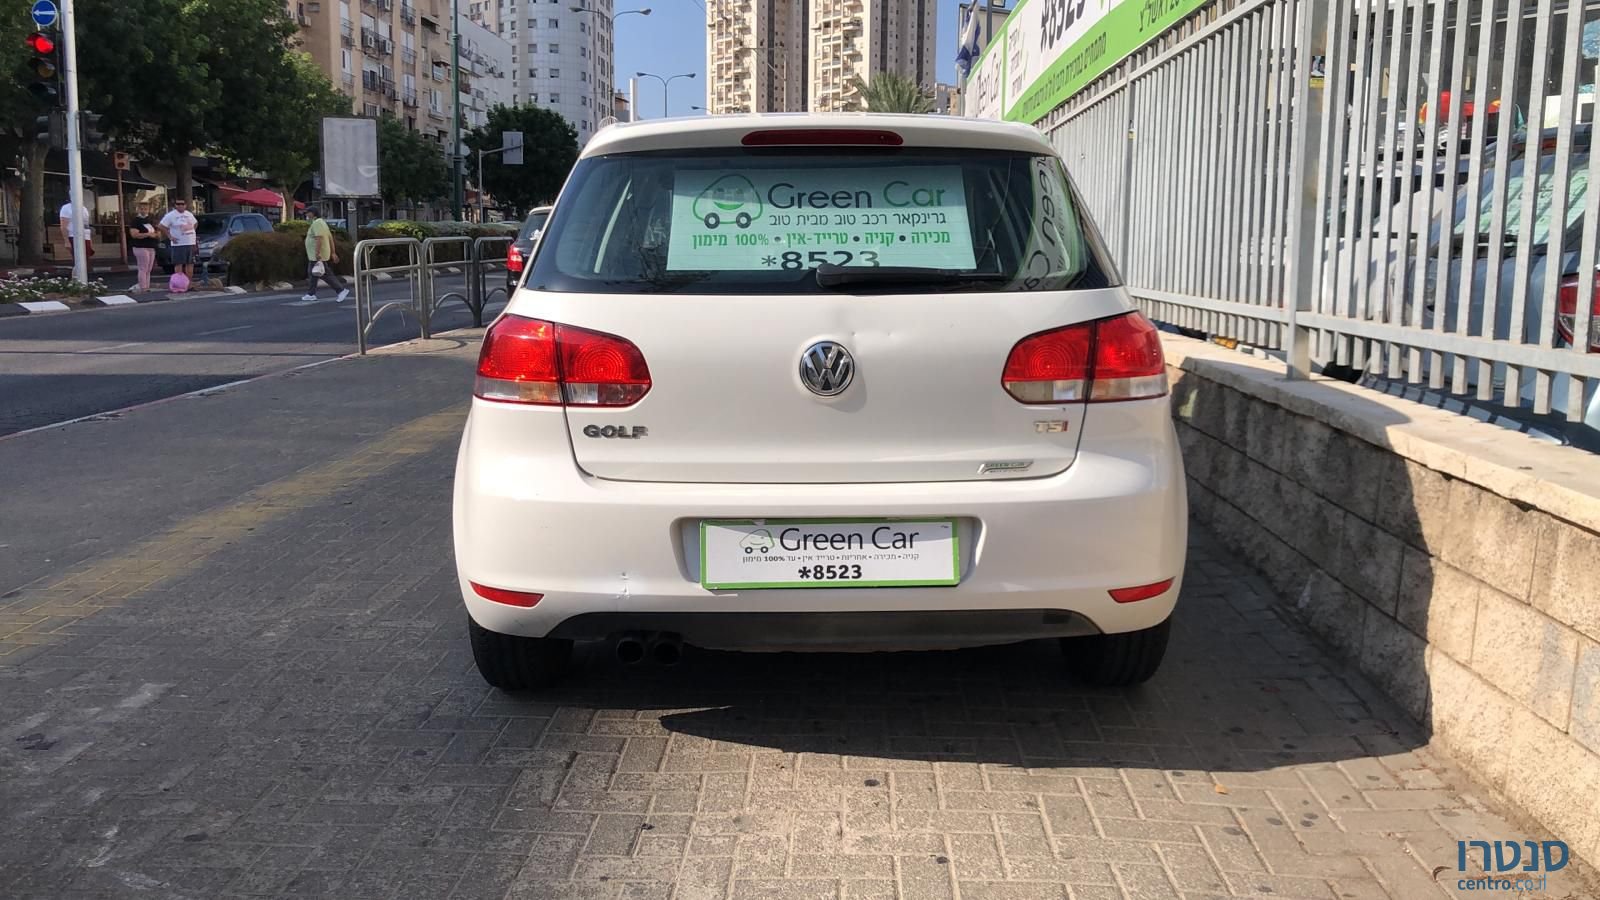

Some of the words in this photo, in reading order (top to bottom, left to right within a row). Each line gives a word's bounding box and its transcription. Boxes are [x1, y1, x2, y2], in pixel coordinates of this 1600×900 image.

[767, 182, 873, 209] Green
[883, 180, 946, 208] Car
[769, 214, 791, 226] טוב
[796, 213, 829, 226] מבית
[834, 214, 856, 226] טוב
[862, 214, 888, 225] רכב
[893, 212, 946, 227] גרינקאר
[692, 234, 728, 250] מימון
[735, 233, 769, 246] 100%
[864, 232, 895, 247] קניה
[911, 231, 950, 243] מכירה
[583, 424, 649, 440] GOLF
[779, 528, 863, 551] Green
[871, 526, 920, 550] Car
[742, 556, 762, 564] מימון
[902, 553, 919, 561] קניה
